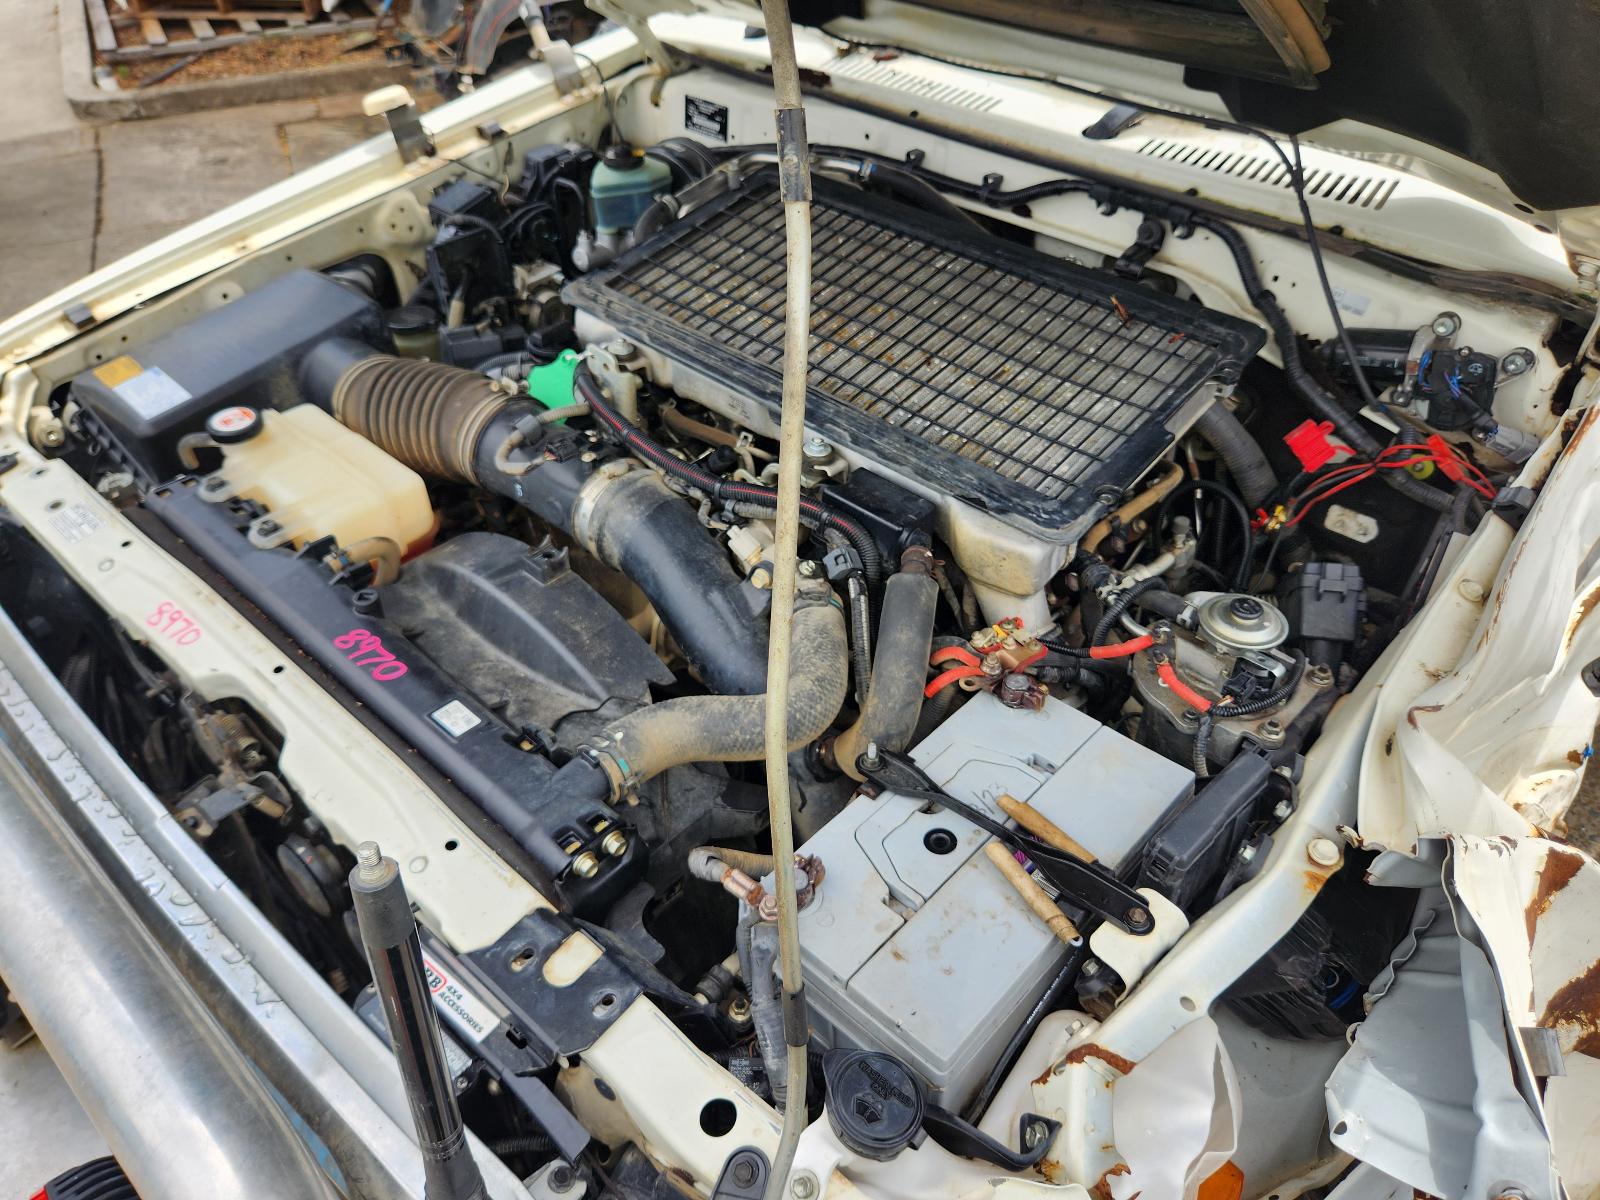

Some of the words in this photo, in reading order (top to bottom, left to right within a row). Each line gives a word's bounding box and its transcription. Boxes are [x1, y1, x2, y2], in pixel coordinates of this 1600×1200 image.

[148, 600, 202, 646] 8970
[334, 629, 409, 682] 8970
[440, 992, 484, 1033] ACCESSORIES
